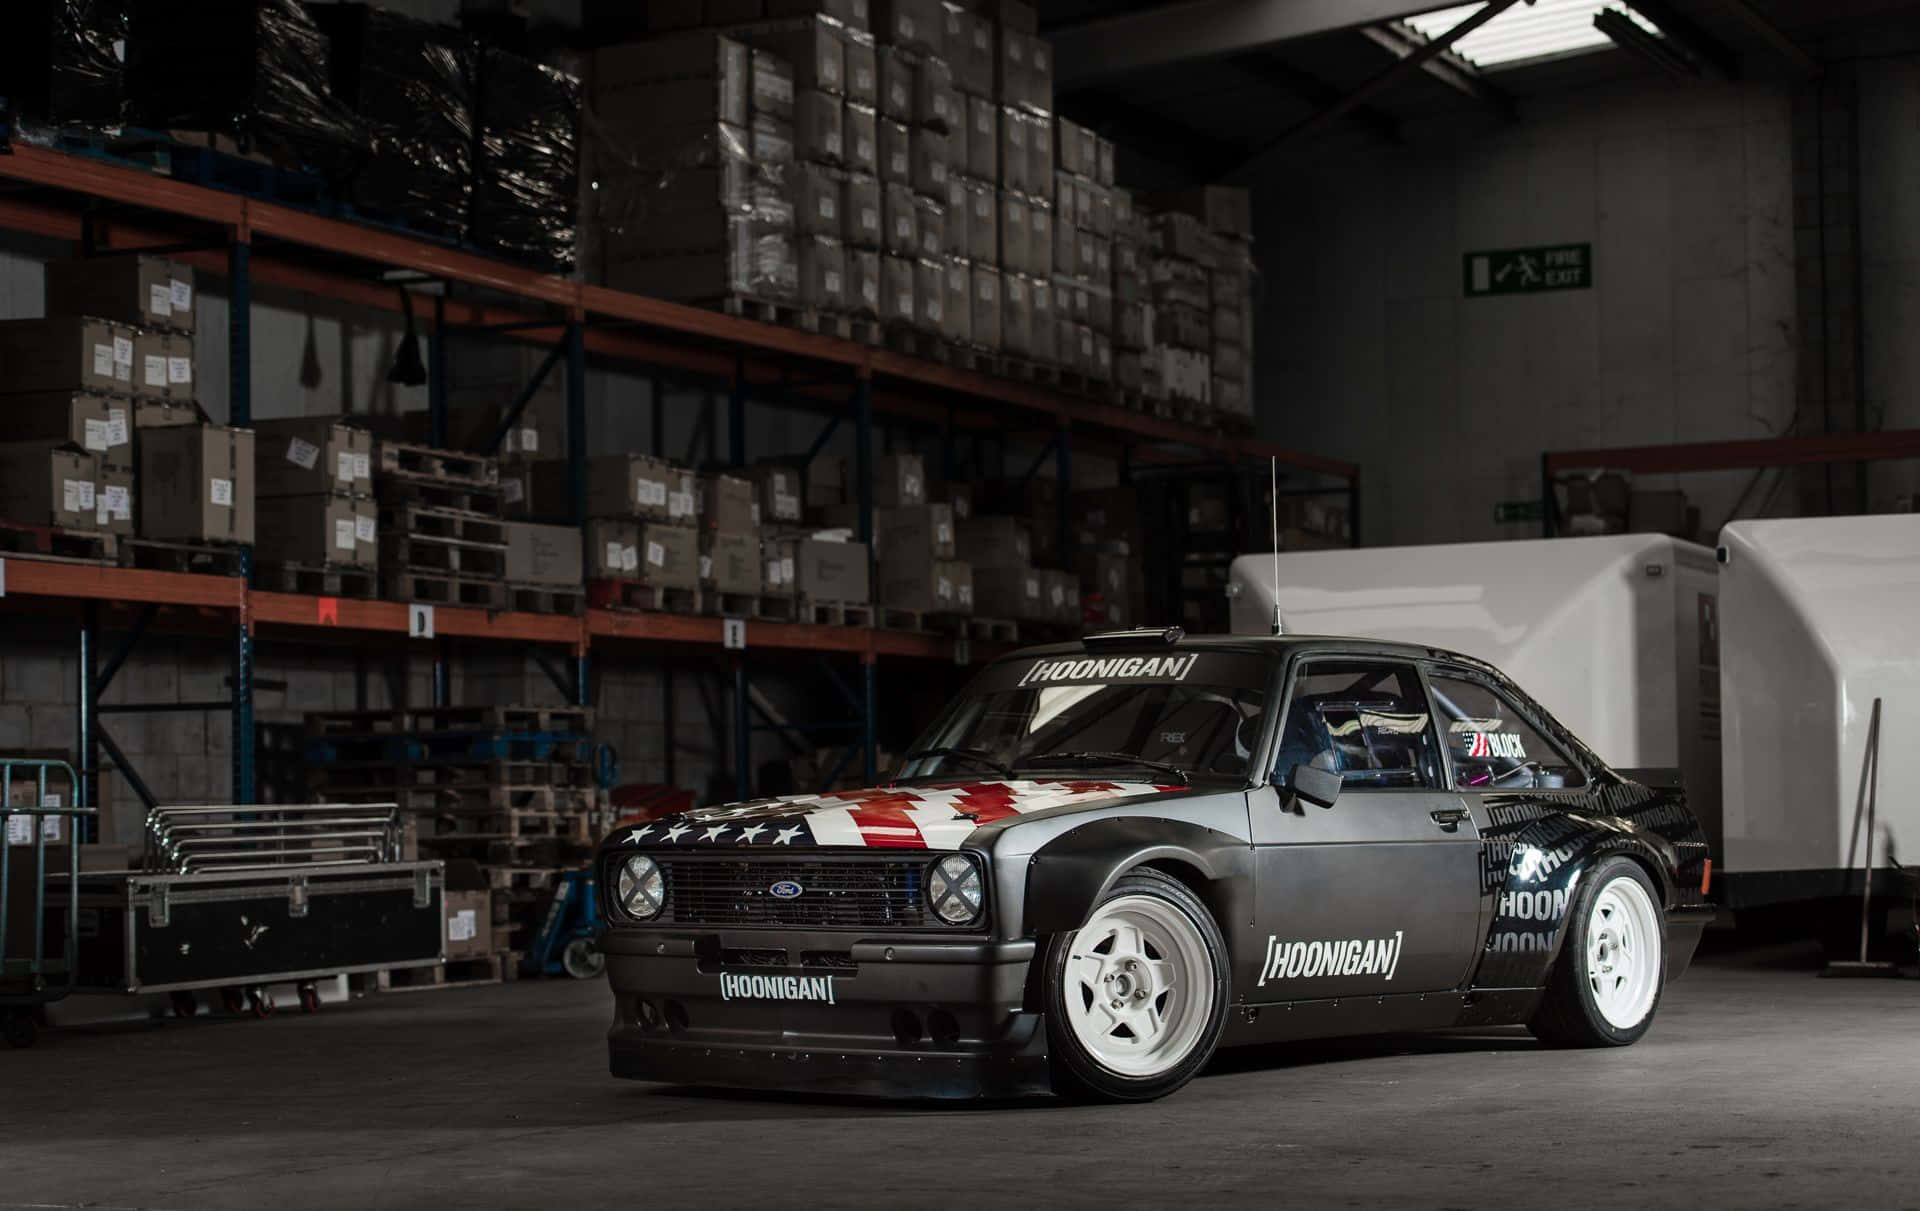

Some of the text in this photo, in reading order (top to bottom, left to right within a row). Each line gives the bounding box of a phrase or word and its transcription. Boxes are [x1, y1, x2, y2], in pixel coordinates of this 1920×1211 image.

[1545, 248, 1584, 266] FIRE
[1545, 267, 1584, 286] EXIT
[417, 611, 426, 633] D
[1017, 653, 1200, 688] [HOONIGAN]
[1488, 732, 1527, 759] BLOCK
[1257, 930, 1403, 988] [HOONIGAN]
[719, 971, 836, 1006] [HOONIGAN]
